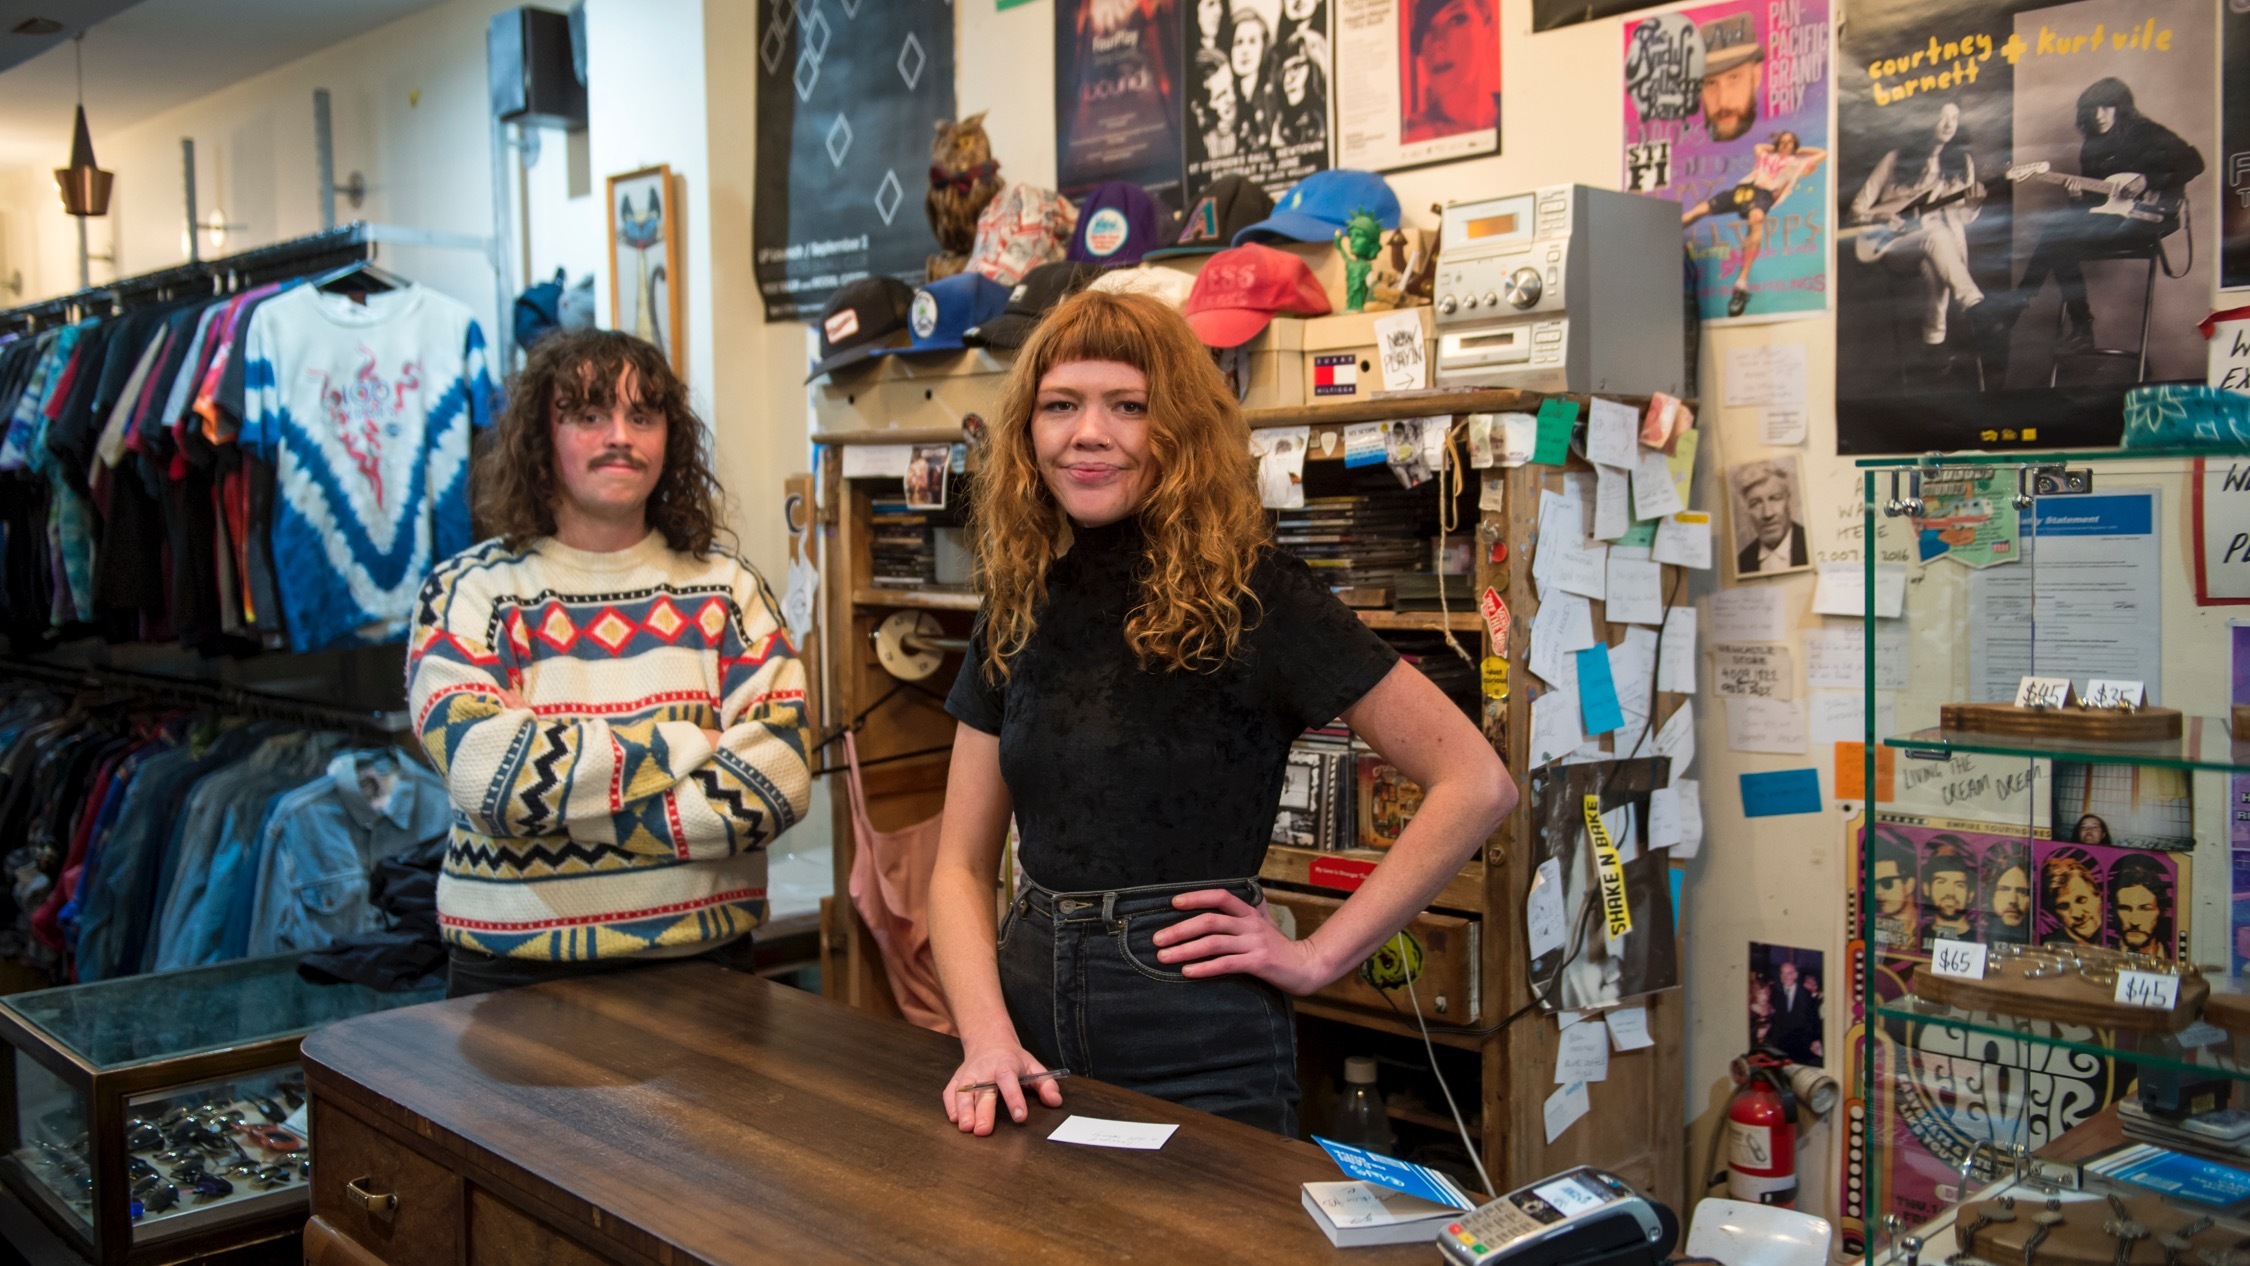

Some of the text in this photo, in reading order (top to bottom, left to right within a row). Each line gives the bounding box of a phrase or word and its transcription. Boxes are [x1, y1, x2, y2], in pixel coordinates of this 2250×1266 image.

[1769, 22, 1829, 61] PACIFIC
[1868, 33, 1993, 80] courtney
[2112, 16, 2174, 52] vile
[1768, 52, 1823, 93] GRAND
[1872, 57, 1980, 107] barnett
[1769, 82, 1807, 120] PRIX
[1836, 524, 1889, 543] HEE
[2022, 680, 2066, 703] $45
[1902, 754, 1976, 790] LIVING THE
[1586, 799, 1627, 937] SHAKE N BAKE
[1939, 951, 1971, 973] $65
[2125, 977, 2168, 1007] $45
